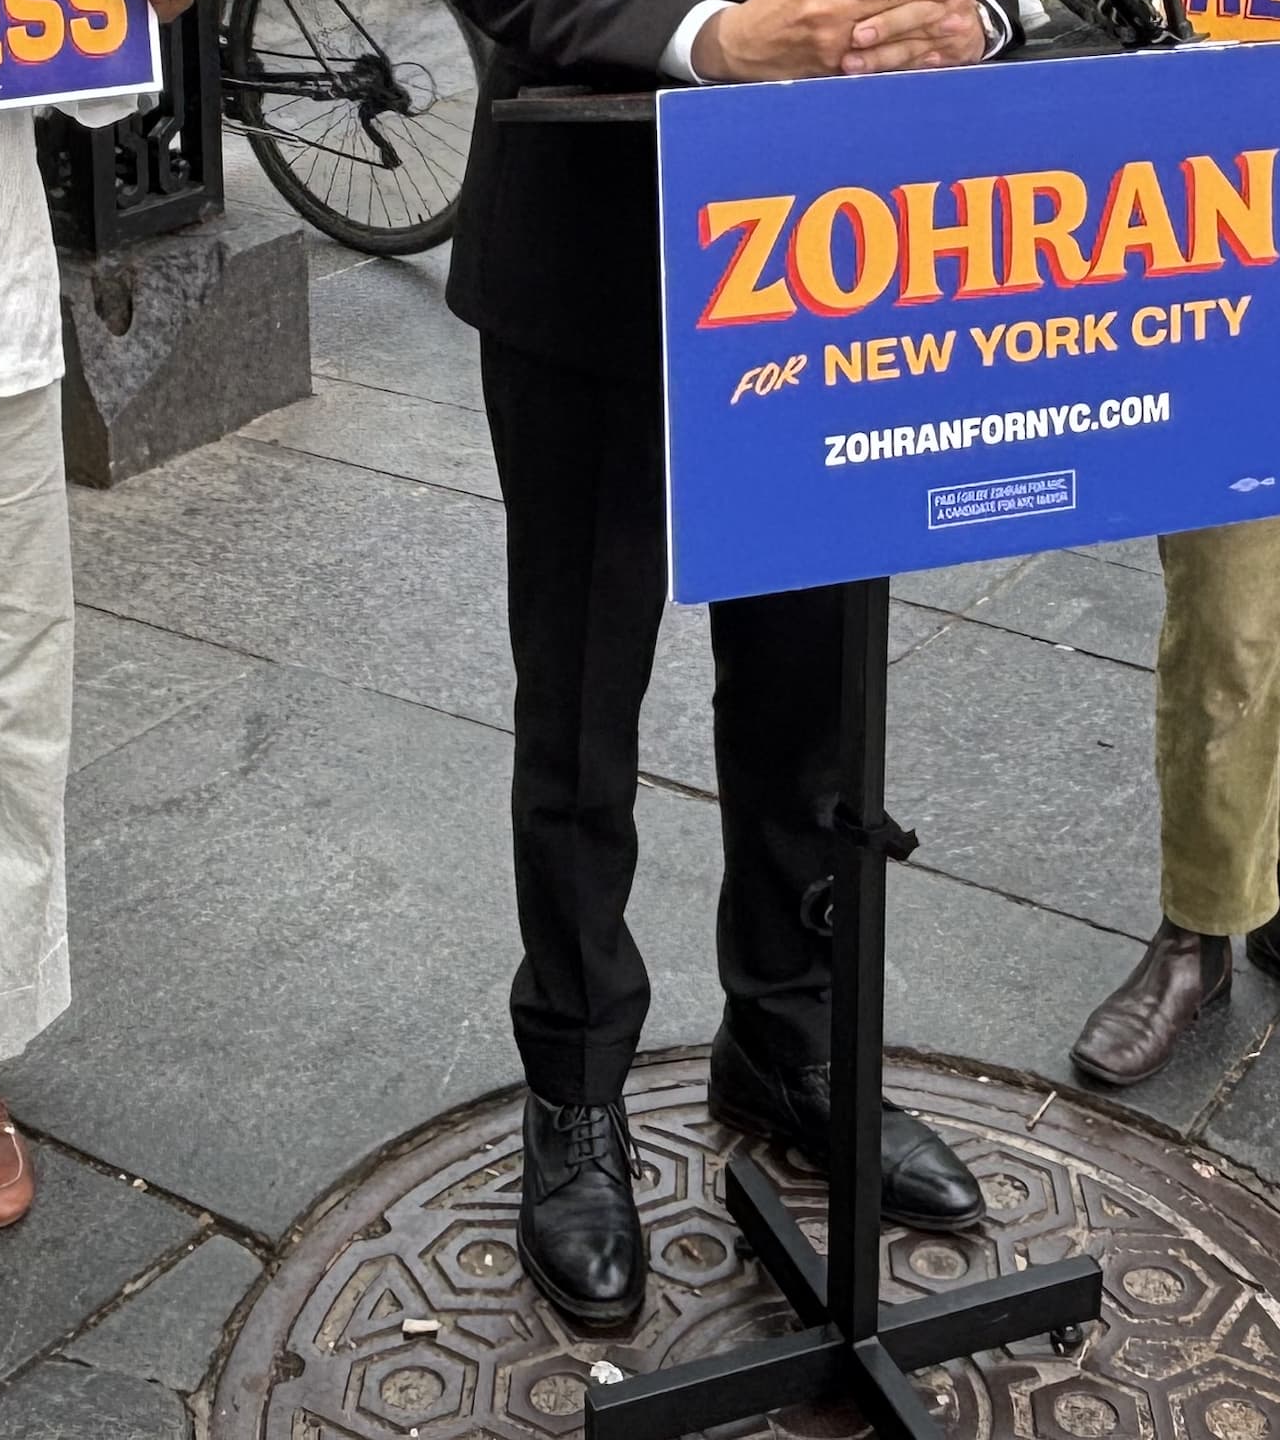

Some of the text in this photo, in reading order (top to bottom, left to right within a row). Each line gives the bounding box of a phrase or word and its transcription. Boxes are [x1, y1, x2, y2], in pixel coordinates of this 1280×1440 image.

[696, 147, 1280, 329] ZOHRAN
[729, 296, 1253, 405] FOR NEW YORK CITY
[824, 392, 1171, 467] ZOHRANFORNYC.COM
